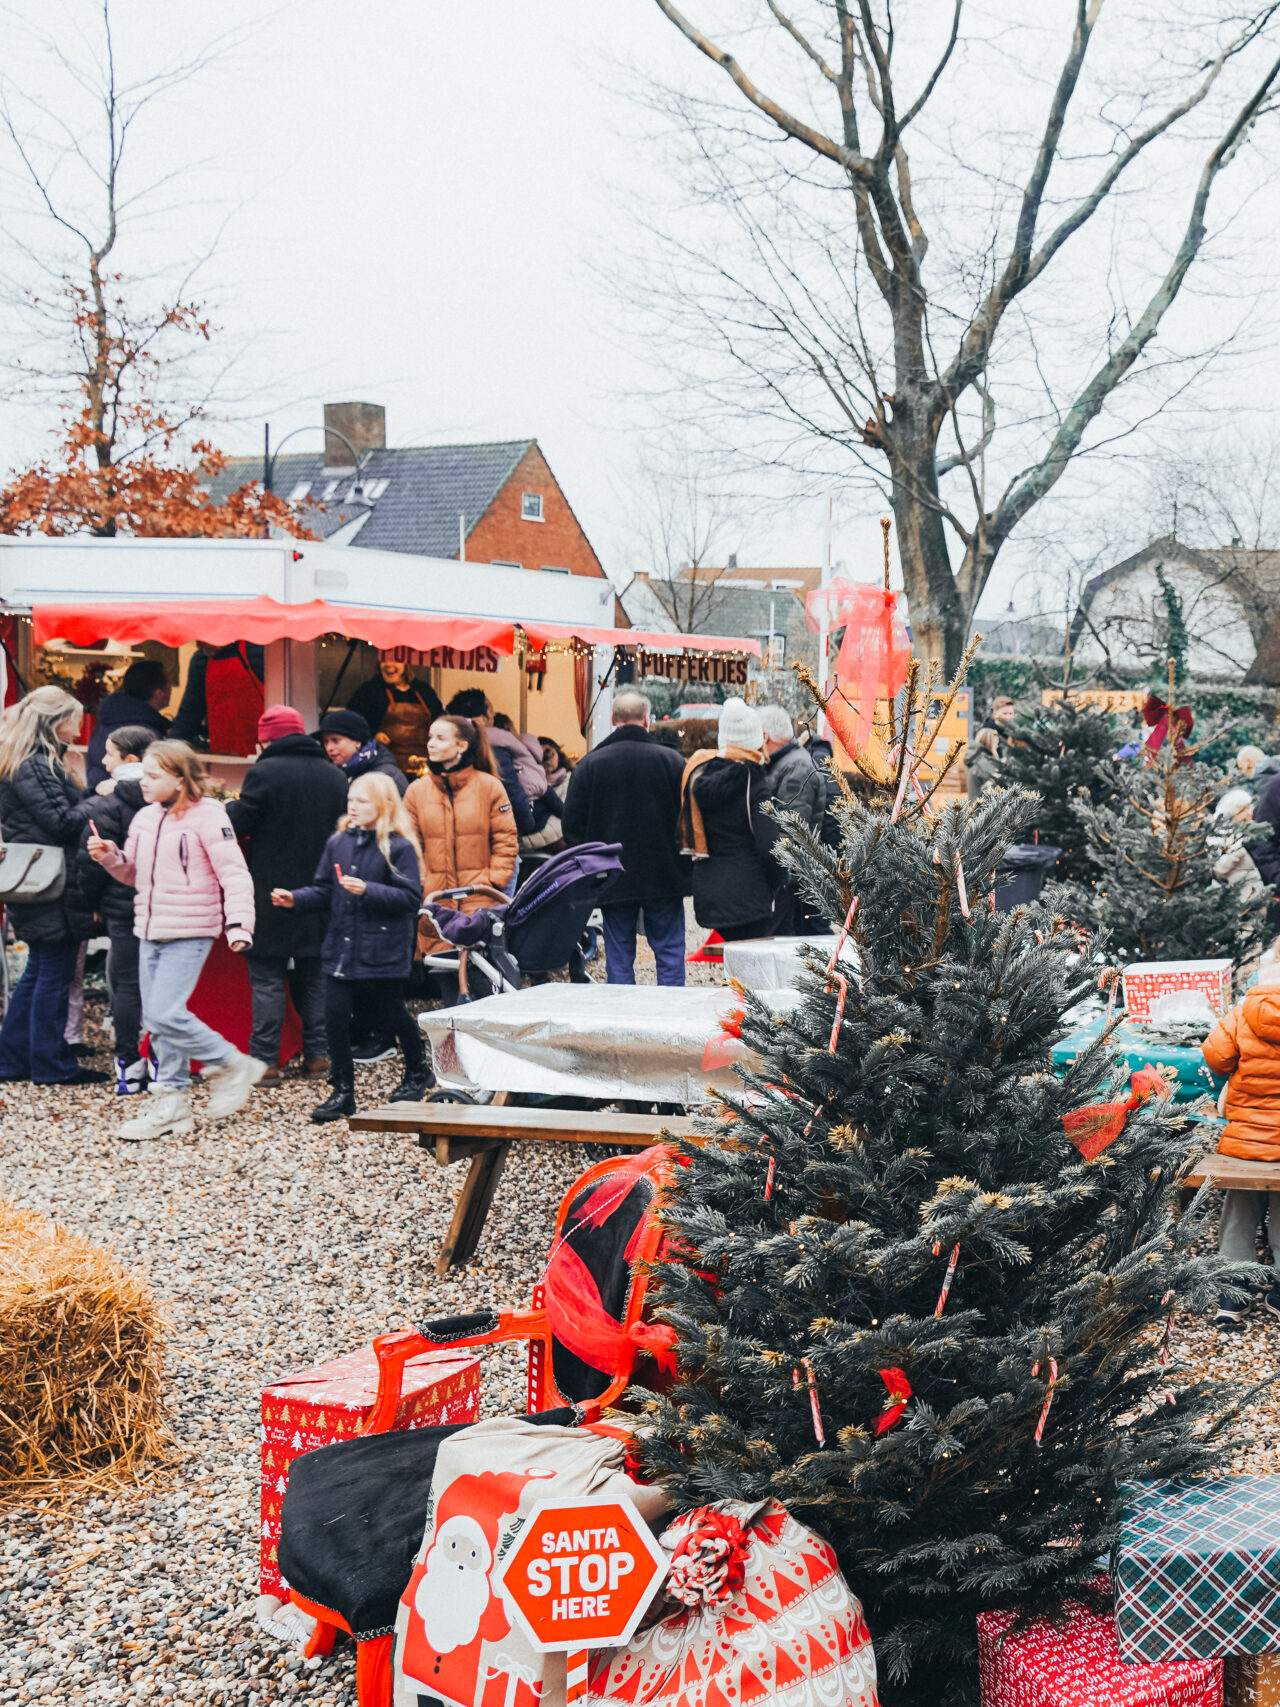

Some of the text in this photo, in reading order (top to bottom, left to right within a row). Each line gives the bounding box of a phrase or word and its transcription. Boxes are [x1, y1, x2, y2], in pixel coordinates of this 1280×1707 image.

[640, 651, 748, 684] PUFFERTJES
[542, 1528, 620, 1554] SANTA
[526, 1552, 635, 1597] STOP
[552, 1594, 610, 1621] HERE
